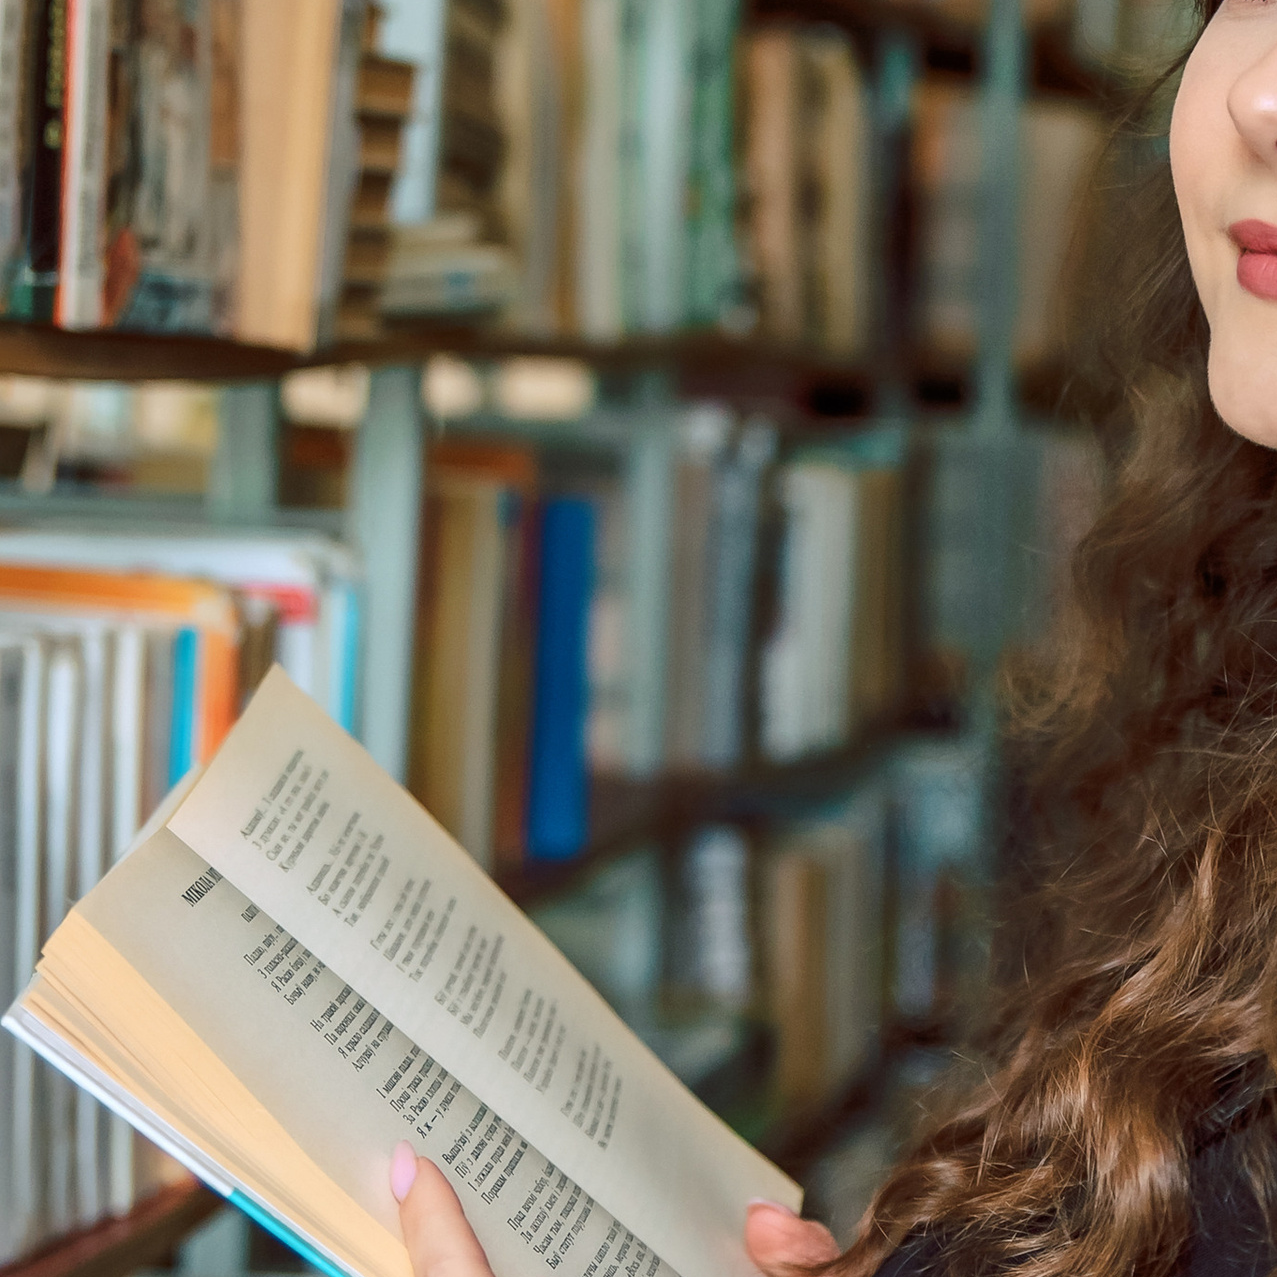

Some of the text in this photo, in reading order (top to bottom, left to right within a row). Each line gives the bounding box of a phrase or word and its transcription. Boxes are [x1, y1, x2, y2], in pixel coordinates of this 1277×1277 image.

[181, 875, 215, 907] МІКОЛА
[271, 980, 282, 993] Я
[310, 1019, 325, 1032] На
[323, 1033, 339, 1046] Па
[370, 1039, 381, 1050] на
[338, 1046, 349, 1059] Я
[402, 1114, 416, 1125] За
[409, 1096, 429, 1116] Расію
[416, 1126, 427, 1139] Я
[442, 1131, 470, 1165] Выпаўзаў
[454, 1161, 471, 1179] Піў
[507, 1210, 526, 1231] Прад
[520, 1230, 534, 1244] Ля
[530, 1206, 549, 1233] акопаў
[533, 1233, 554, 1255] Часам
[549, 1219, 564, 1236] тым,
[545, 1251, 563, 1270] Быў
[559, 1232, 575, 1255] статут
